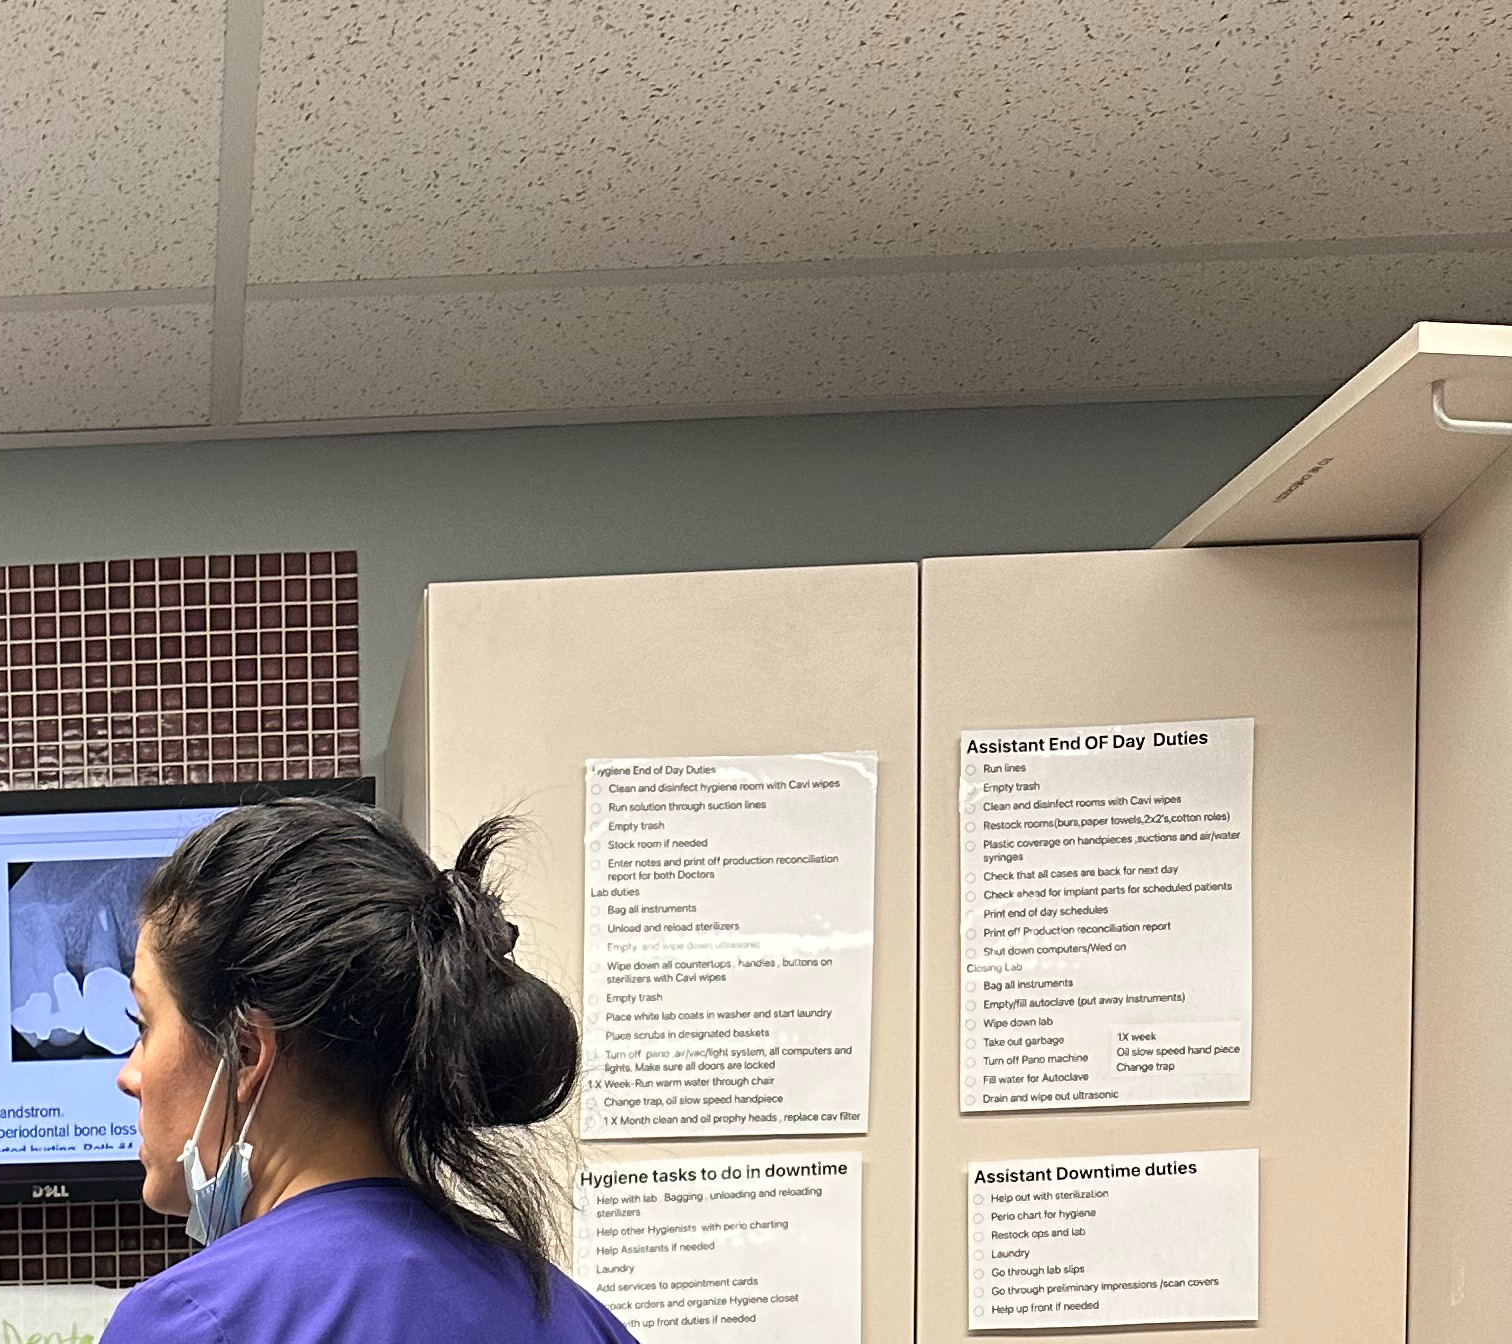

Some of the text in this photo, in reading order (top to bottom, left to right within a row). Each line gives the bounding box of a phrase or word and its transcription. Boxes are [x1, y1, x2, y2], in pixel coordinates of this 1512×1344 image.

[967, 730, 1208, 754] Assistant End OF Day Duties
[74, 1123, 106, 1137] bone
[111, 1122, 138, 1136] loss
[580, 1160, 847, 1188] Hygiene tasks to do in downtime
[975, 1160, 1197, 1184] Assistant Downtime duties
[32, 1184, 70, 1199] DELL
